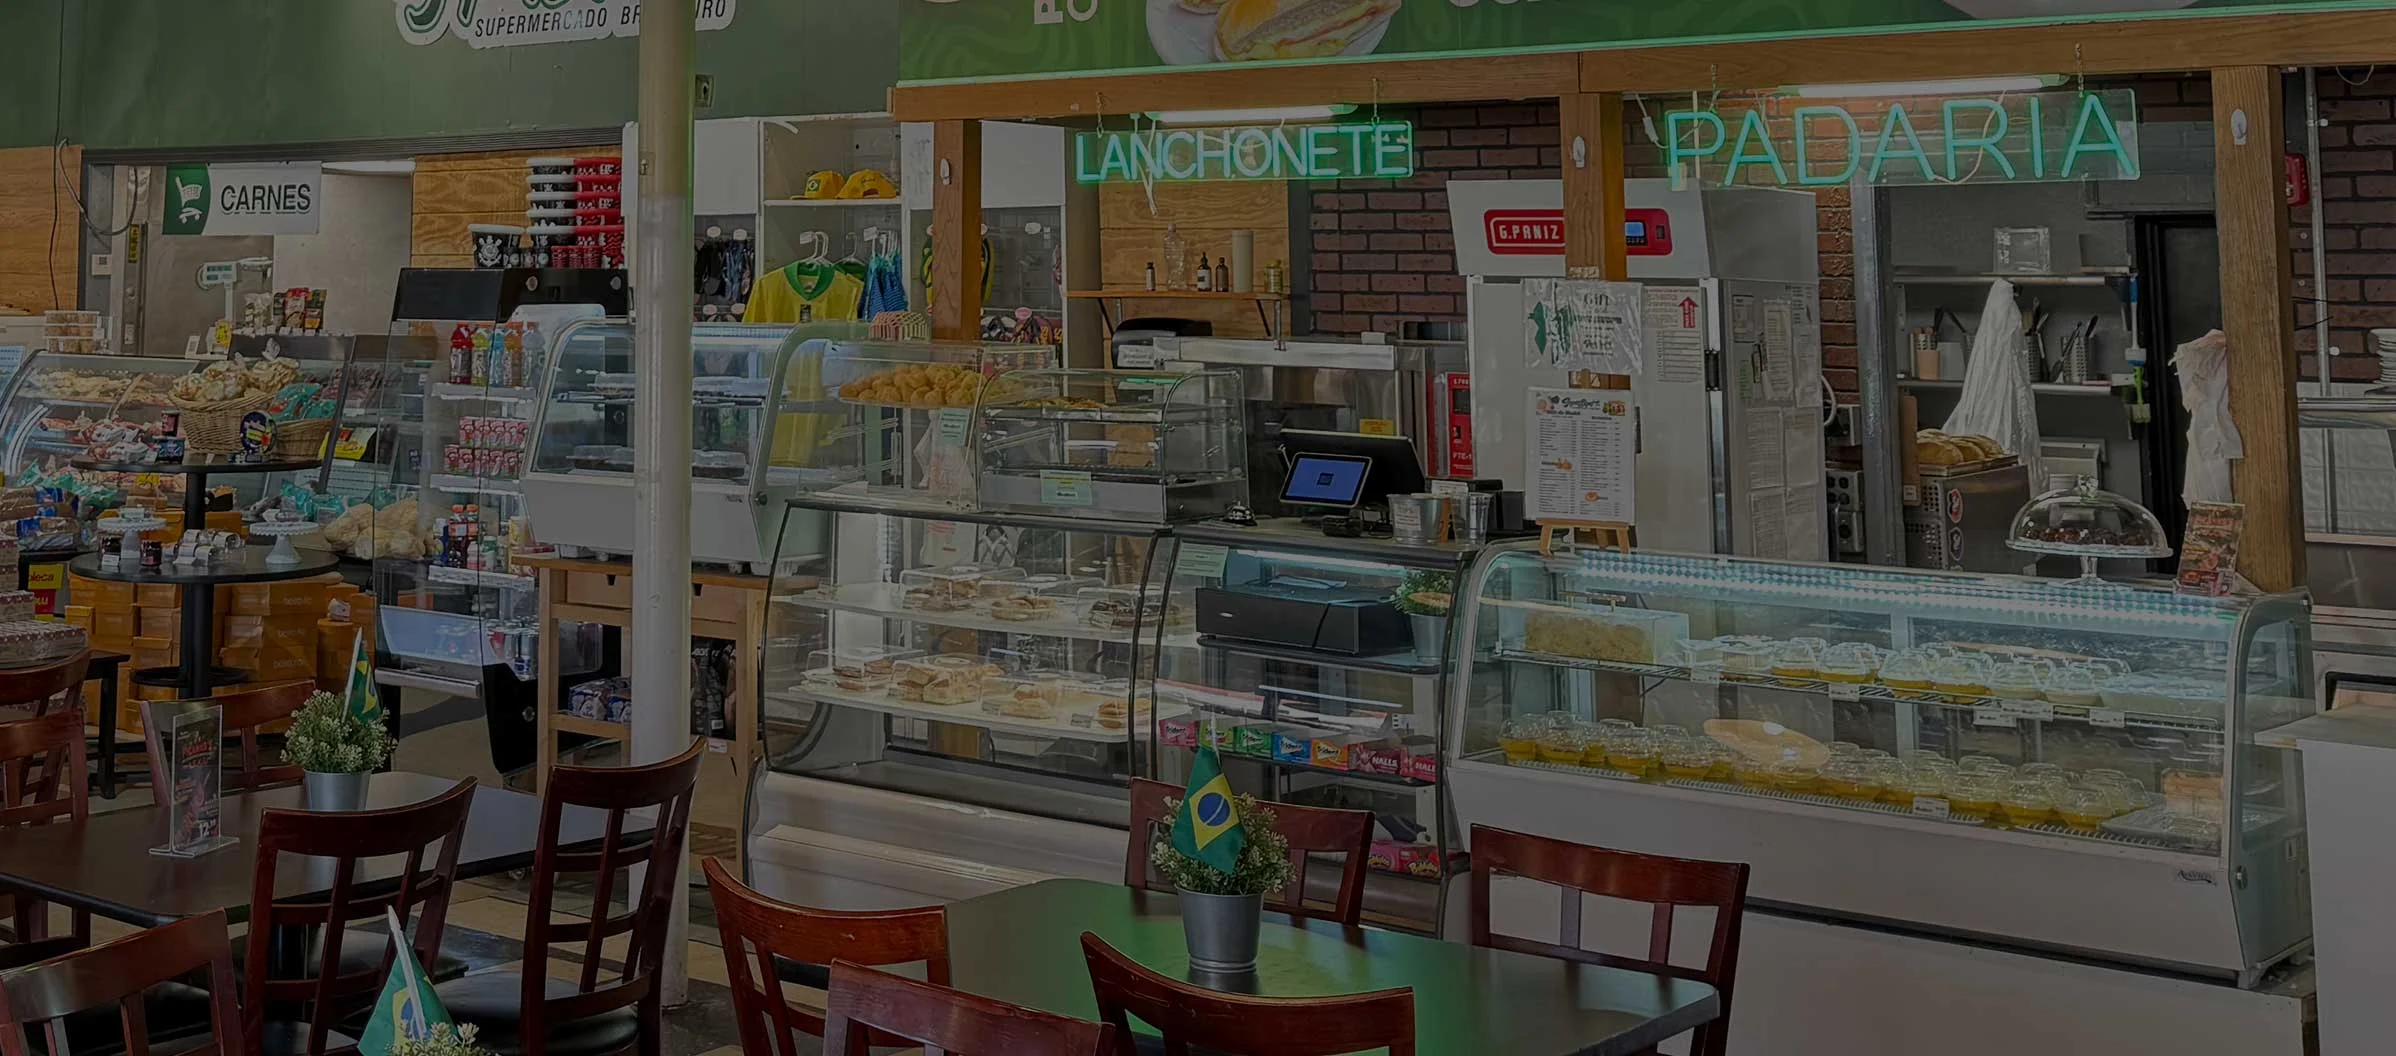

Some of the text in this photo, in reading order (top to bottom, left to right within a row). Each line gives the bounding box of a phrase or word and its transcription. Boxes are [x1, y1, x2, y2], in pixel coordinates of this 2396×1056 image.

[476, 7, 607, 37] SUPERMERCADO
[1076, 123, 1409, 182] LANCHONETE
[1667, 93, 2140, 191] PADARIA
[221, 183, 311, 212] CARNES
[1371, 755, 1398, 768] HALLS
